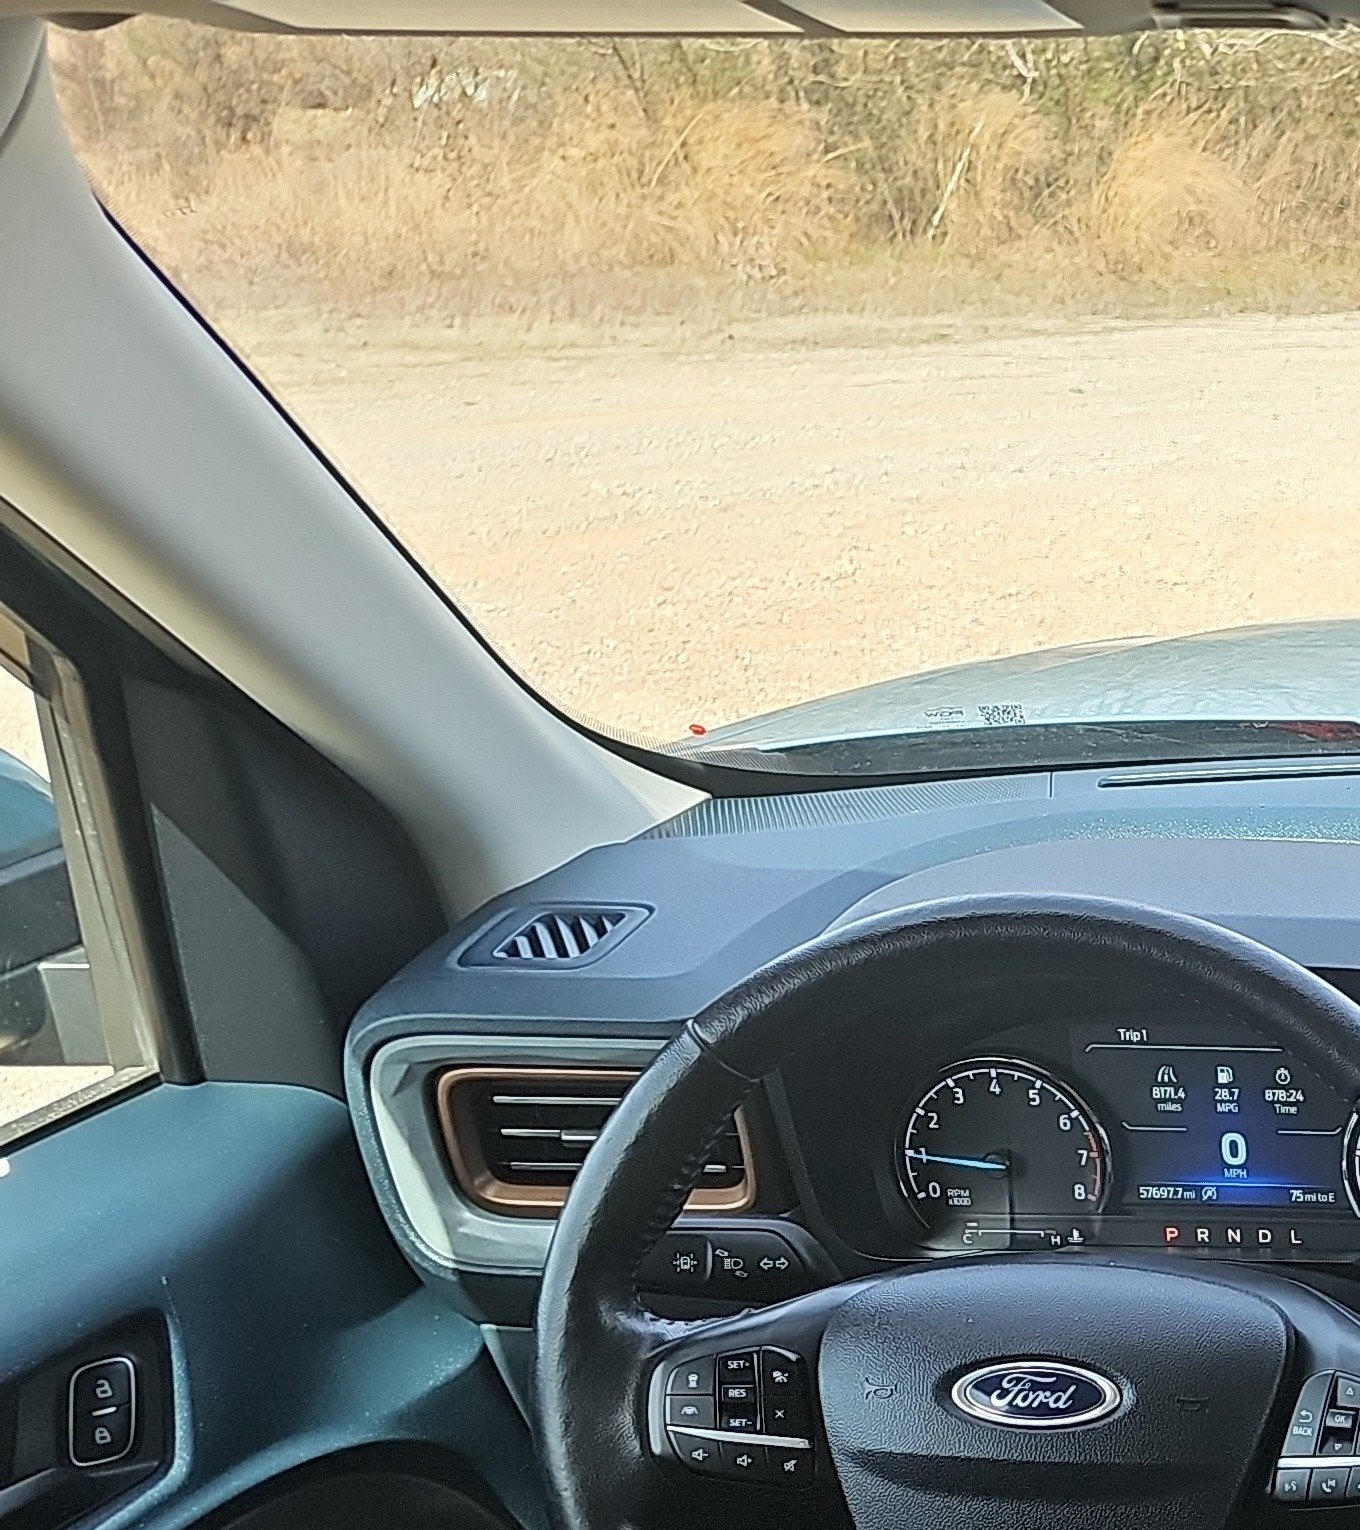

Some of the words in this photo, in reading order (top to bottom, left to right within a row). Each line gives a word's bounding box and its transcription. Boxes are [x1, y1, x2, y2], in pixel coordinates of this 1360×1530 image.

[1117, 1028, 1141, 1042] Trip
[989, 1079, 1000, 1094] 4
[953, 1089, 964, 1104] 3
[1029, 1089, 1040, 1105] 5
[1152, 1087, 1186, 1100] 8171.4
[1214, 1088, 1239, 1101] 28.7
[1264, 1090, 1304, 1102] 878:24
[1157, 1103, 1182, 1112] miles
[1216, 1103, 1239, 1113] MPG
[1274, 1104, 1298, 1115] Time
[928, 1113, 939, 1128] 2
[1059, 1114, 1070, 1130] 6
[1220, 1132, 1247, 1166] 0
[1078, 1151, 1087, 1165] 7
[1224, 1168, 1248, 1179] MPH
[928, 1182, 940, 1198] 0
[948, 1189, 970, 1197] RPM
[1074, 1184, 1085, 1200] 8
[1139, 1186, 1183, 1199] 57697.7
[1184, 1190, 1195, 1199] mi
[1290, 1190, 1303, 1202] 75
[1304, 1192, 1316, 1202] mi
[1317, 1193, 1328, 1202] to
[1329, 1193, 1335, 1202] E
[963, 1234, 972, 1244] C
[1051, 1236, 1061, 1245] H
[1165, 1227, 1179, 1242] P
[1196, 1228, 1209, 1242] R
[1228, 1229, 1241, 1243] N
[1258, 1230, 1272, 1243] D
[1290, 1230, 1302, 1244] L
[728, 1388, 747, 1398] RES
[989, 1372, 1077, 1409] Ford
[1334, 1414, 1346, 1423] OK
[1292, 1425, 1313, 1437] BACK
